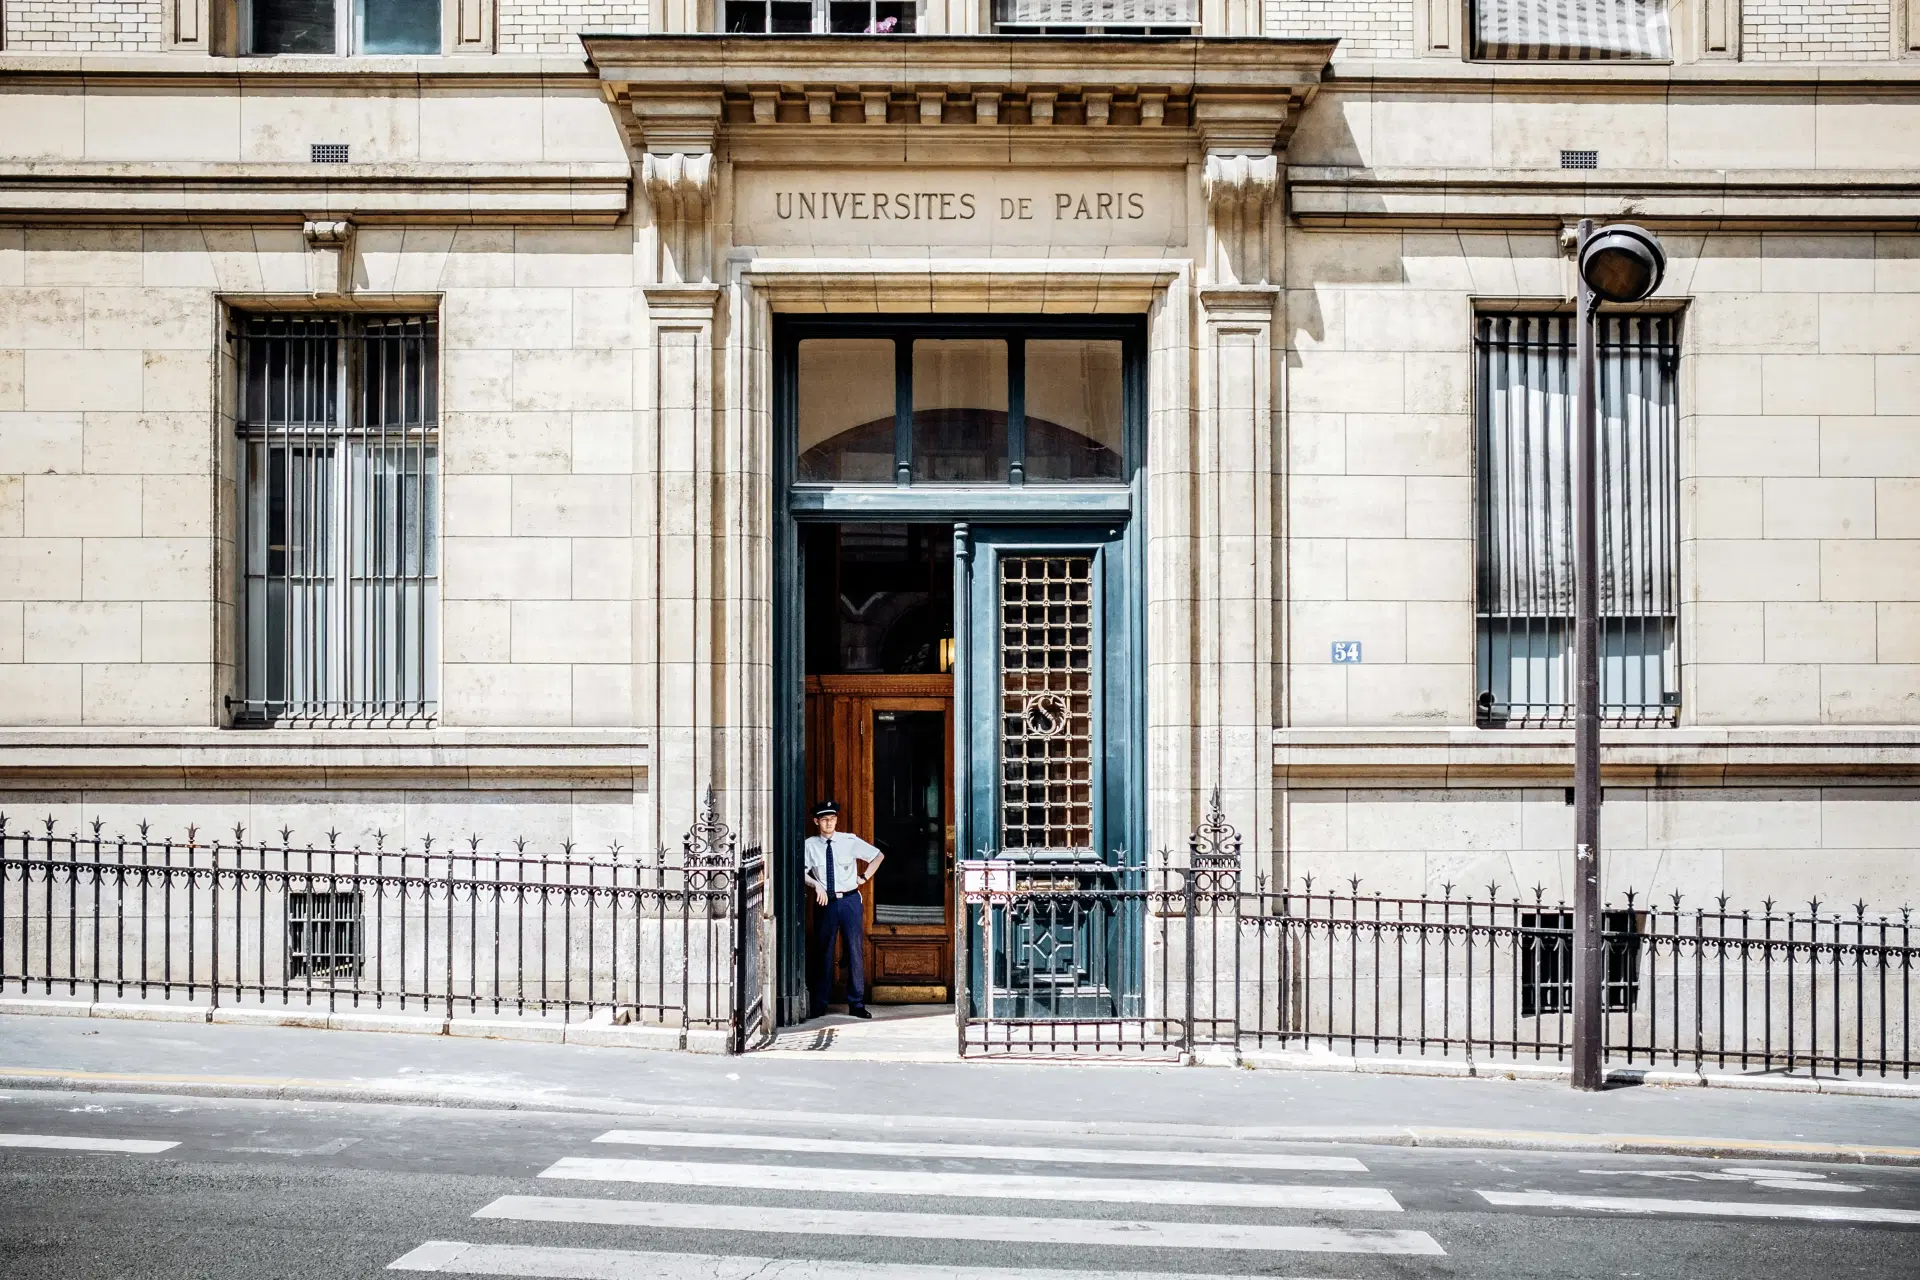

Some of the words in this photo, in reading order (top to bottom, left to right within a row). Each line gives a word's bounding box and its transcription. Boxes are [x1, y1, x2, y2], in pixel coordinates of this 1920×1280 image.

[775, 191, 977, 221] UNIVERSITES
[1000, 197, 1033, 220] DE
[1055, 192, 1145, 221] PARIS
[1334, 642, 1359, 662] 54
